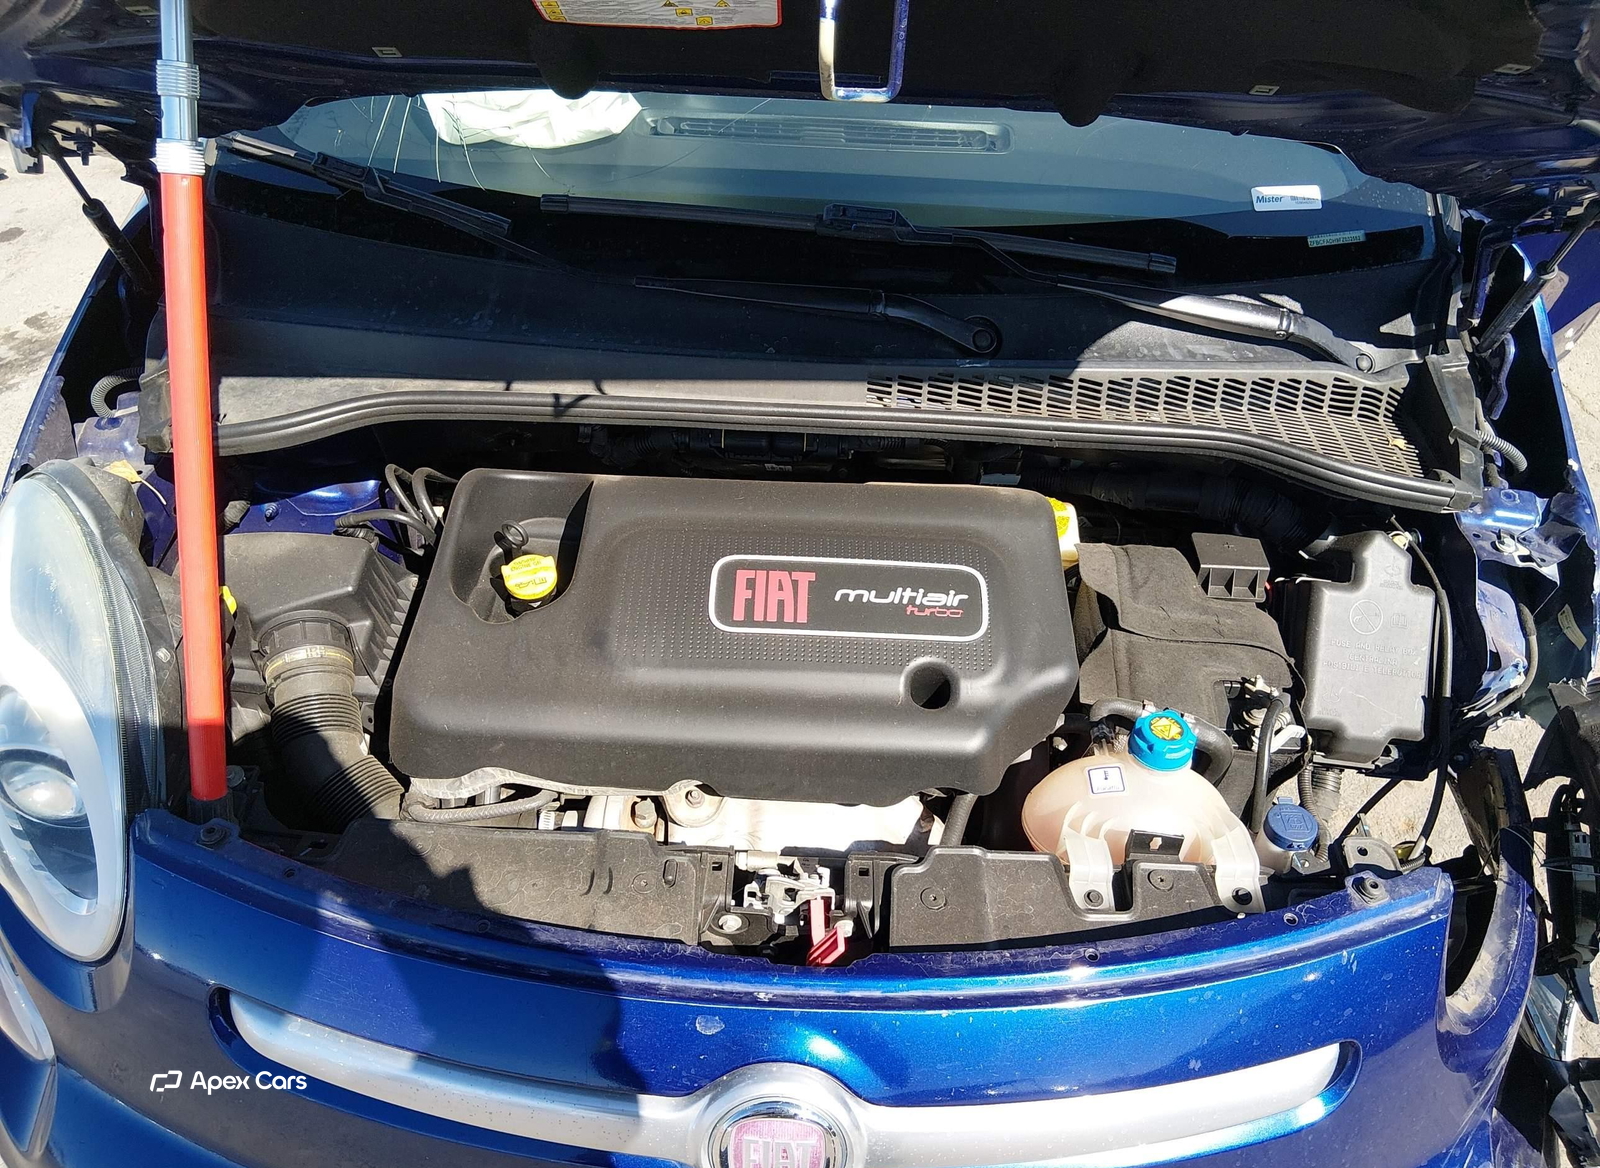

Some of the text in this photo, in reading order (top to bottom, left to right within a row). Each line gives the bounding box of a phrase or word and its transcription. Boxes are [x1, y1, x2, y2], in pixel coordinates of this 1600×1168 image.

[1256, 195, 1283, 204] Mister
[733, 569, 969, 624] FIAT multiair
[906, 604, 965, 618] turbo
[1331, 639, 1351, 648] FUSE
[1355, 641, 1371, 651] AND
[1375, 643, 1399, 654] RELAY
[743, 1136, 818, 1168] FIAT
